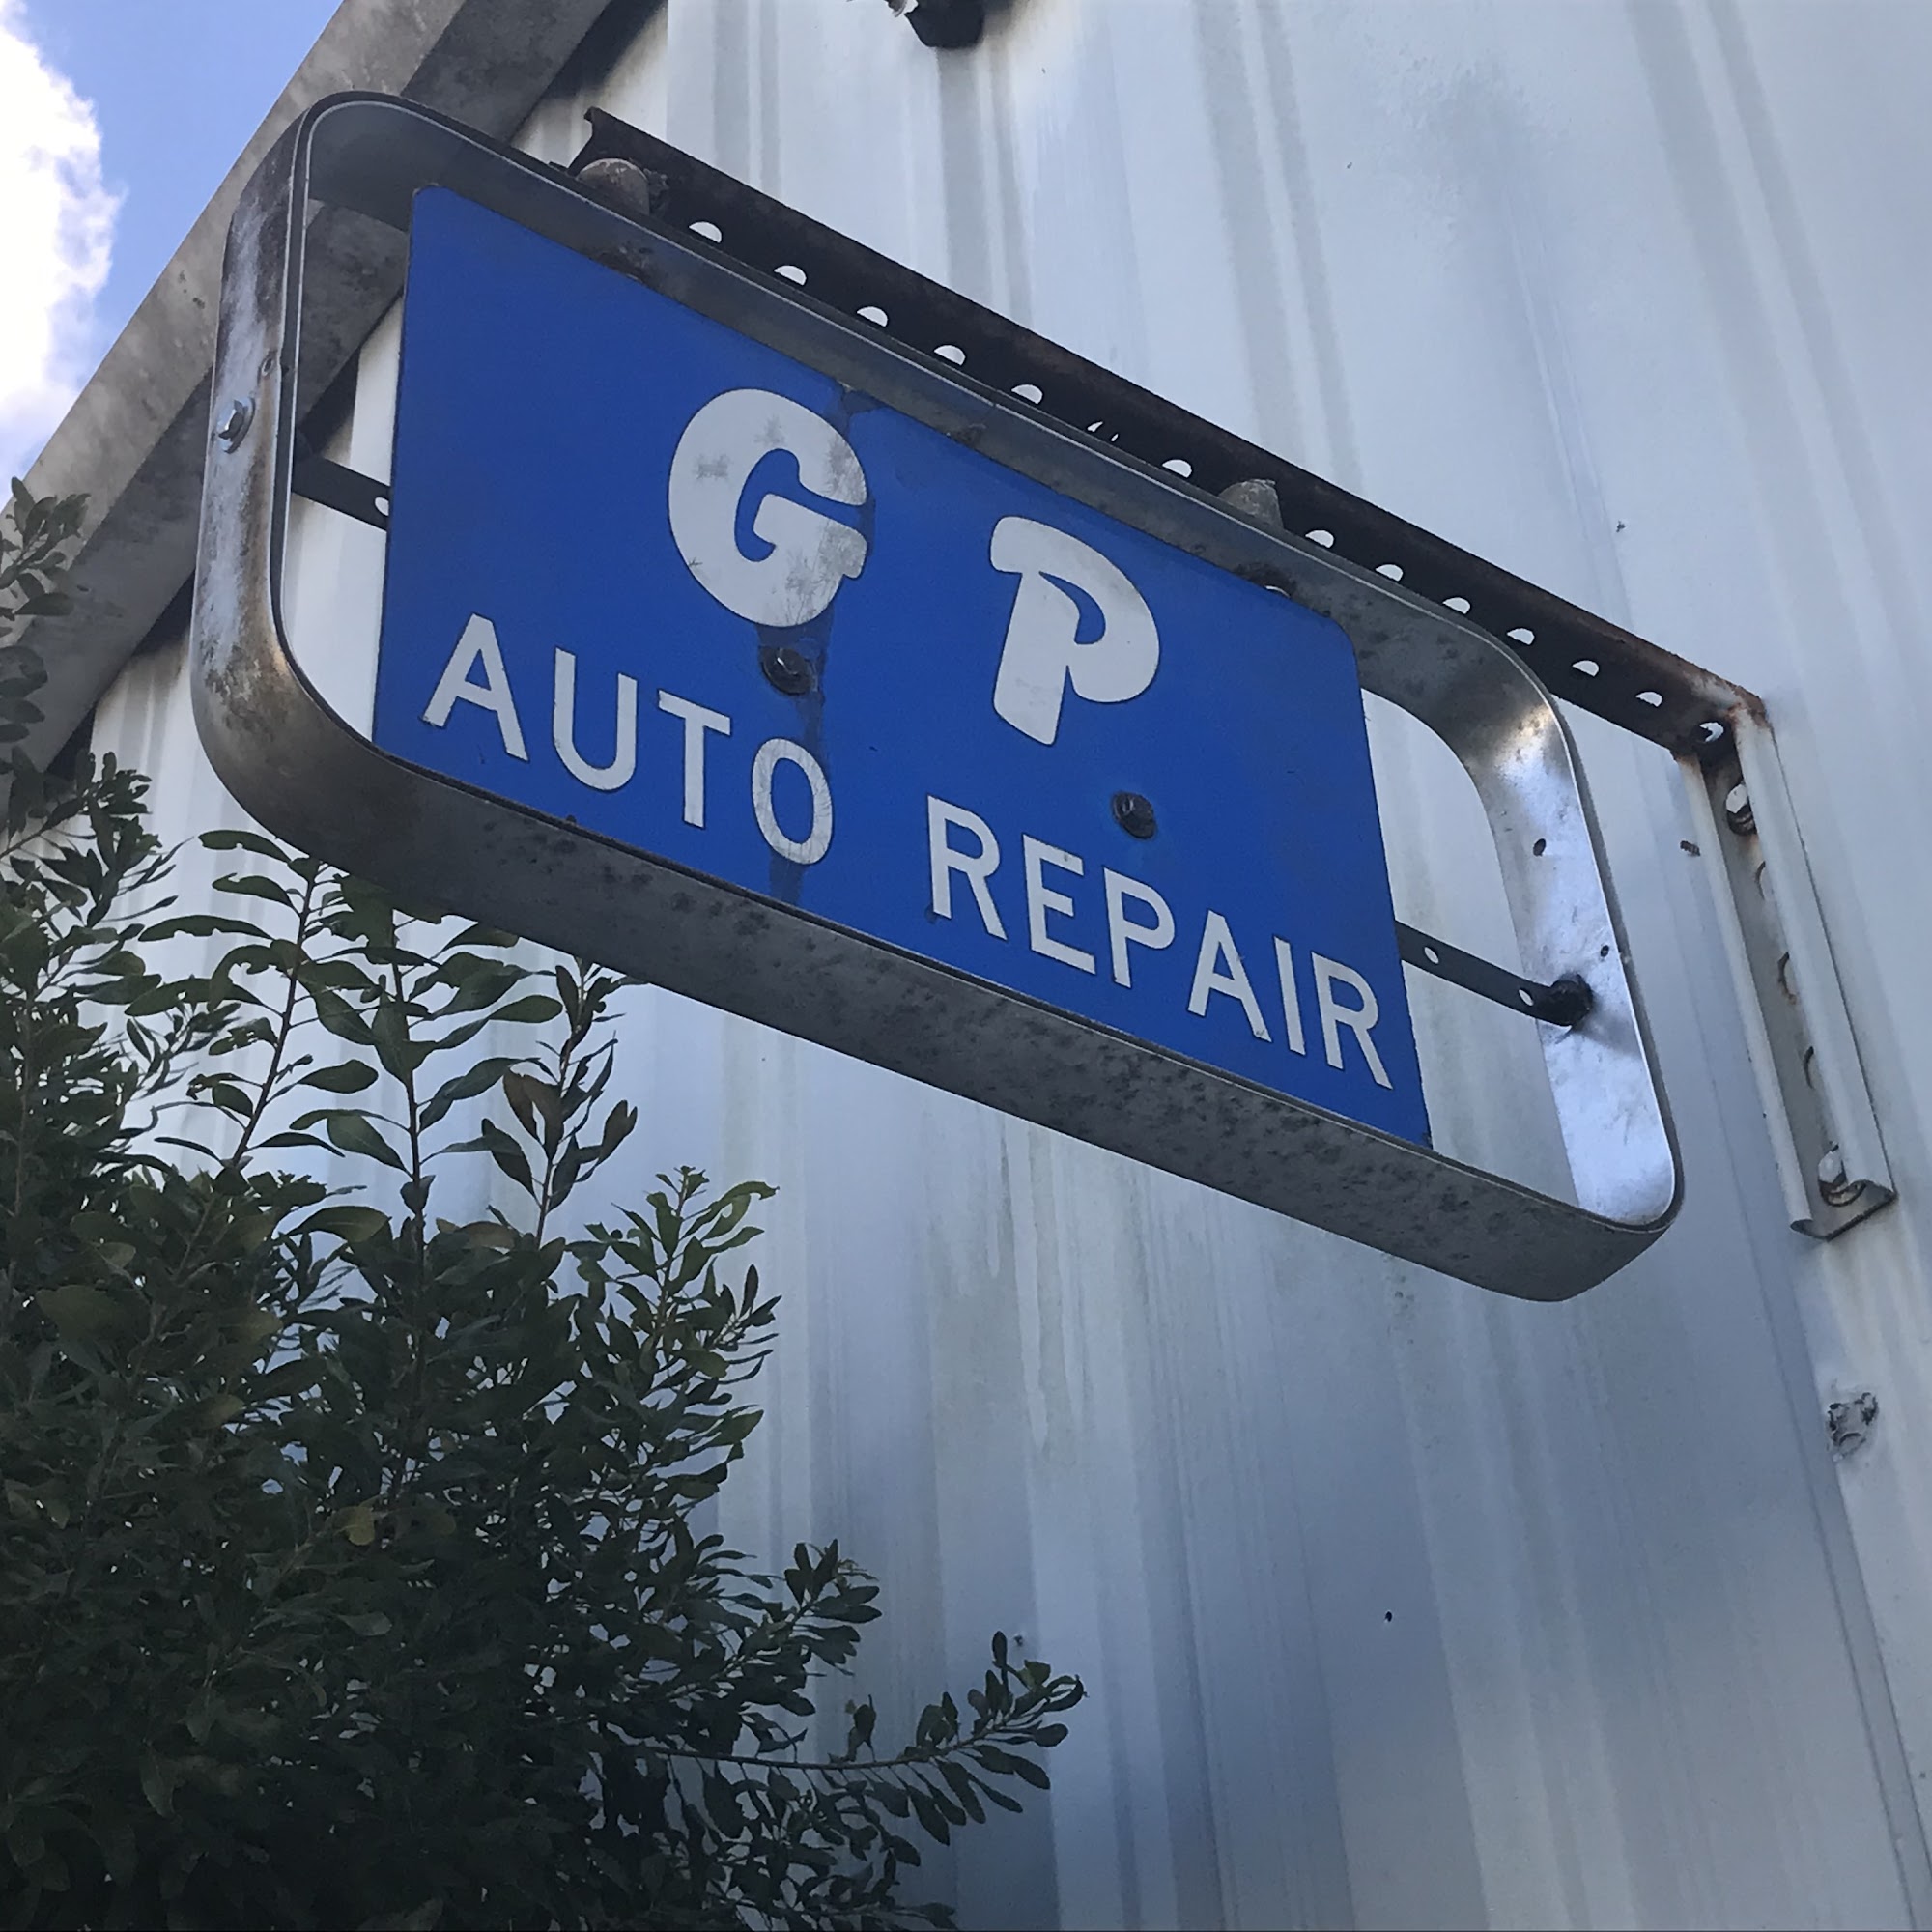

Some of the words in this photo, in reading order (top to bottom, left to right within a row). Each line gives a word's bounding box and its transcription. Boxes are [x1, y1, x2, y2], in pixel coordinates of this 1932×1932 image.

[668, 388, 868, 628] G
[989, 516, 1161, 745] P
[422, 613, 834, 866] AUTO
[926, 795, 1393, 1090] REPAIR
